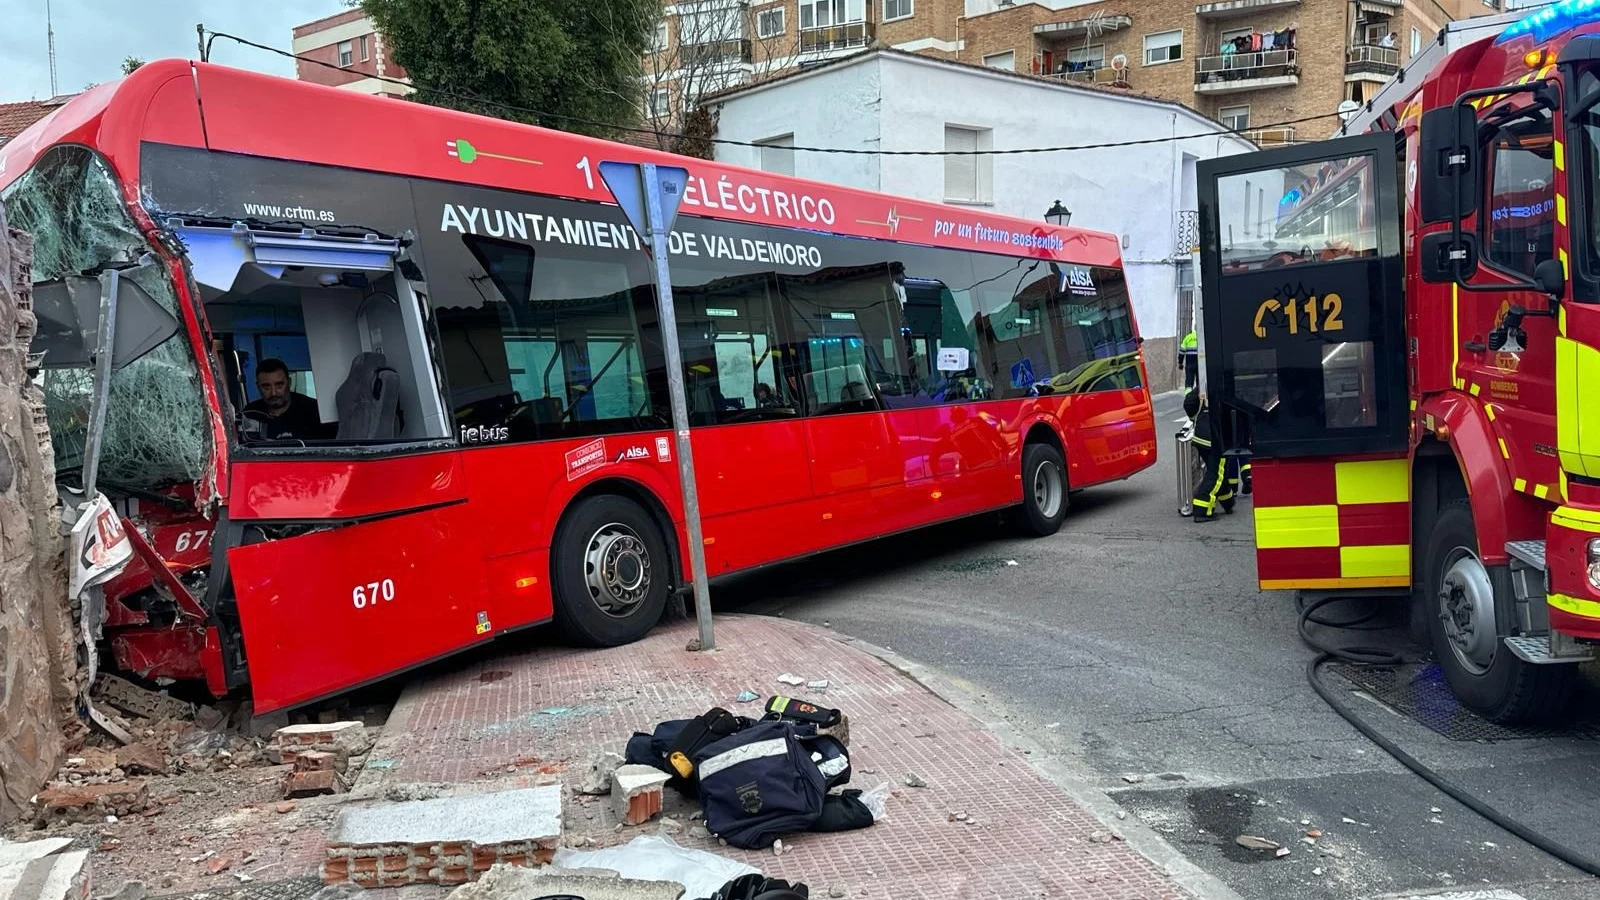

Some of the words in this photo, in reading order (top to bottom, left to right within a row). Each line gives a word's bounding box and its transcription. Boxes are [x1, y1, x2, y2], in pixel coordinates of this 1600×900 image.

[243, 203, 336, 222] www.crtm.es
[683, 175, 836, 225] ELÉCTRICO
[440, 203, 641, 251] AYUNTAMIENT
[668, 231, 700, 256] DE
[701, 233, 823, 268] VALDEMORO
[933, 219, 956, 237] por
[958, 223, 972, 238] un
[974, 222, 1010, 243] futuro
[1011, 232, 1064, 251] sostenible
[1284, 293, 1344, 335] 112
[352, 578, 395, 609] 670
